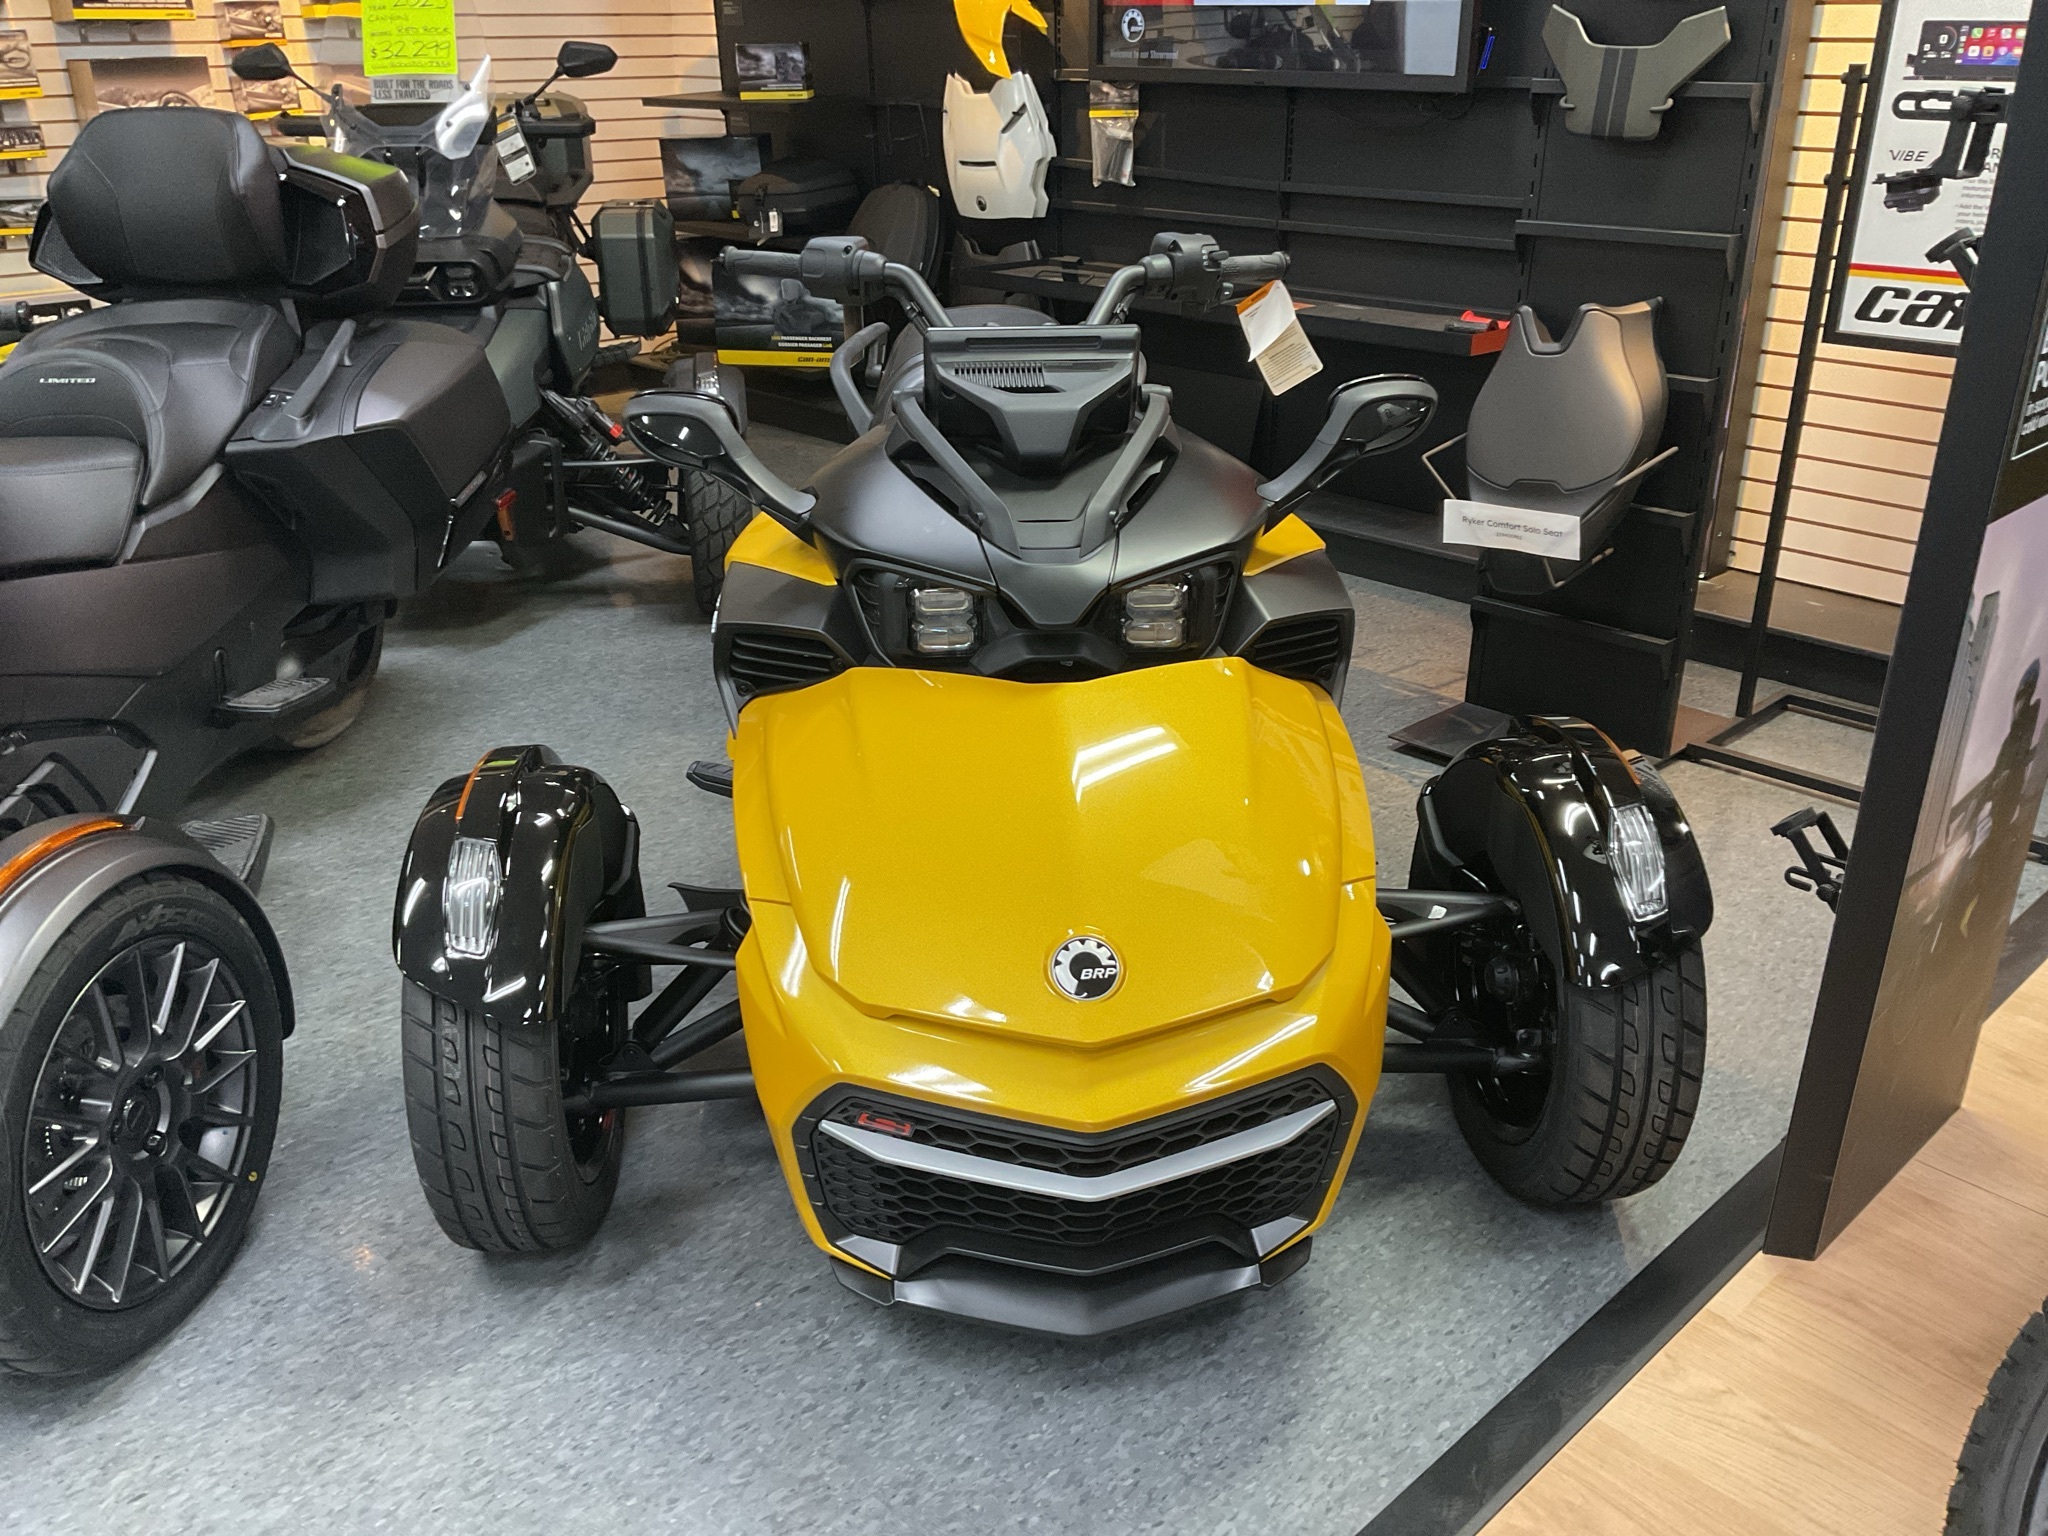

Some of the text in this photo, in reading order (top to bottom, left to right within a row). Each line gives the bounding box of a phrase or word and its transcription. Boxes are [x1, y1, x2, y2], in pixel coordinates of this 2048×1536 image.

[373, 79, 454, 90] BUILT FOR THE ROADS
[374, 89, 431, 100] LESS TRAVELED
[1889, 149, 1929, 162] VIBE
[1462, 516, 1563, 538] Ryker Comfort Solo Seat
[1081, 968, 1116, 980] BRP
